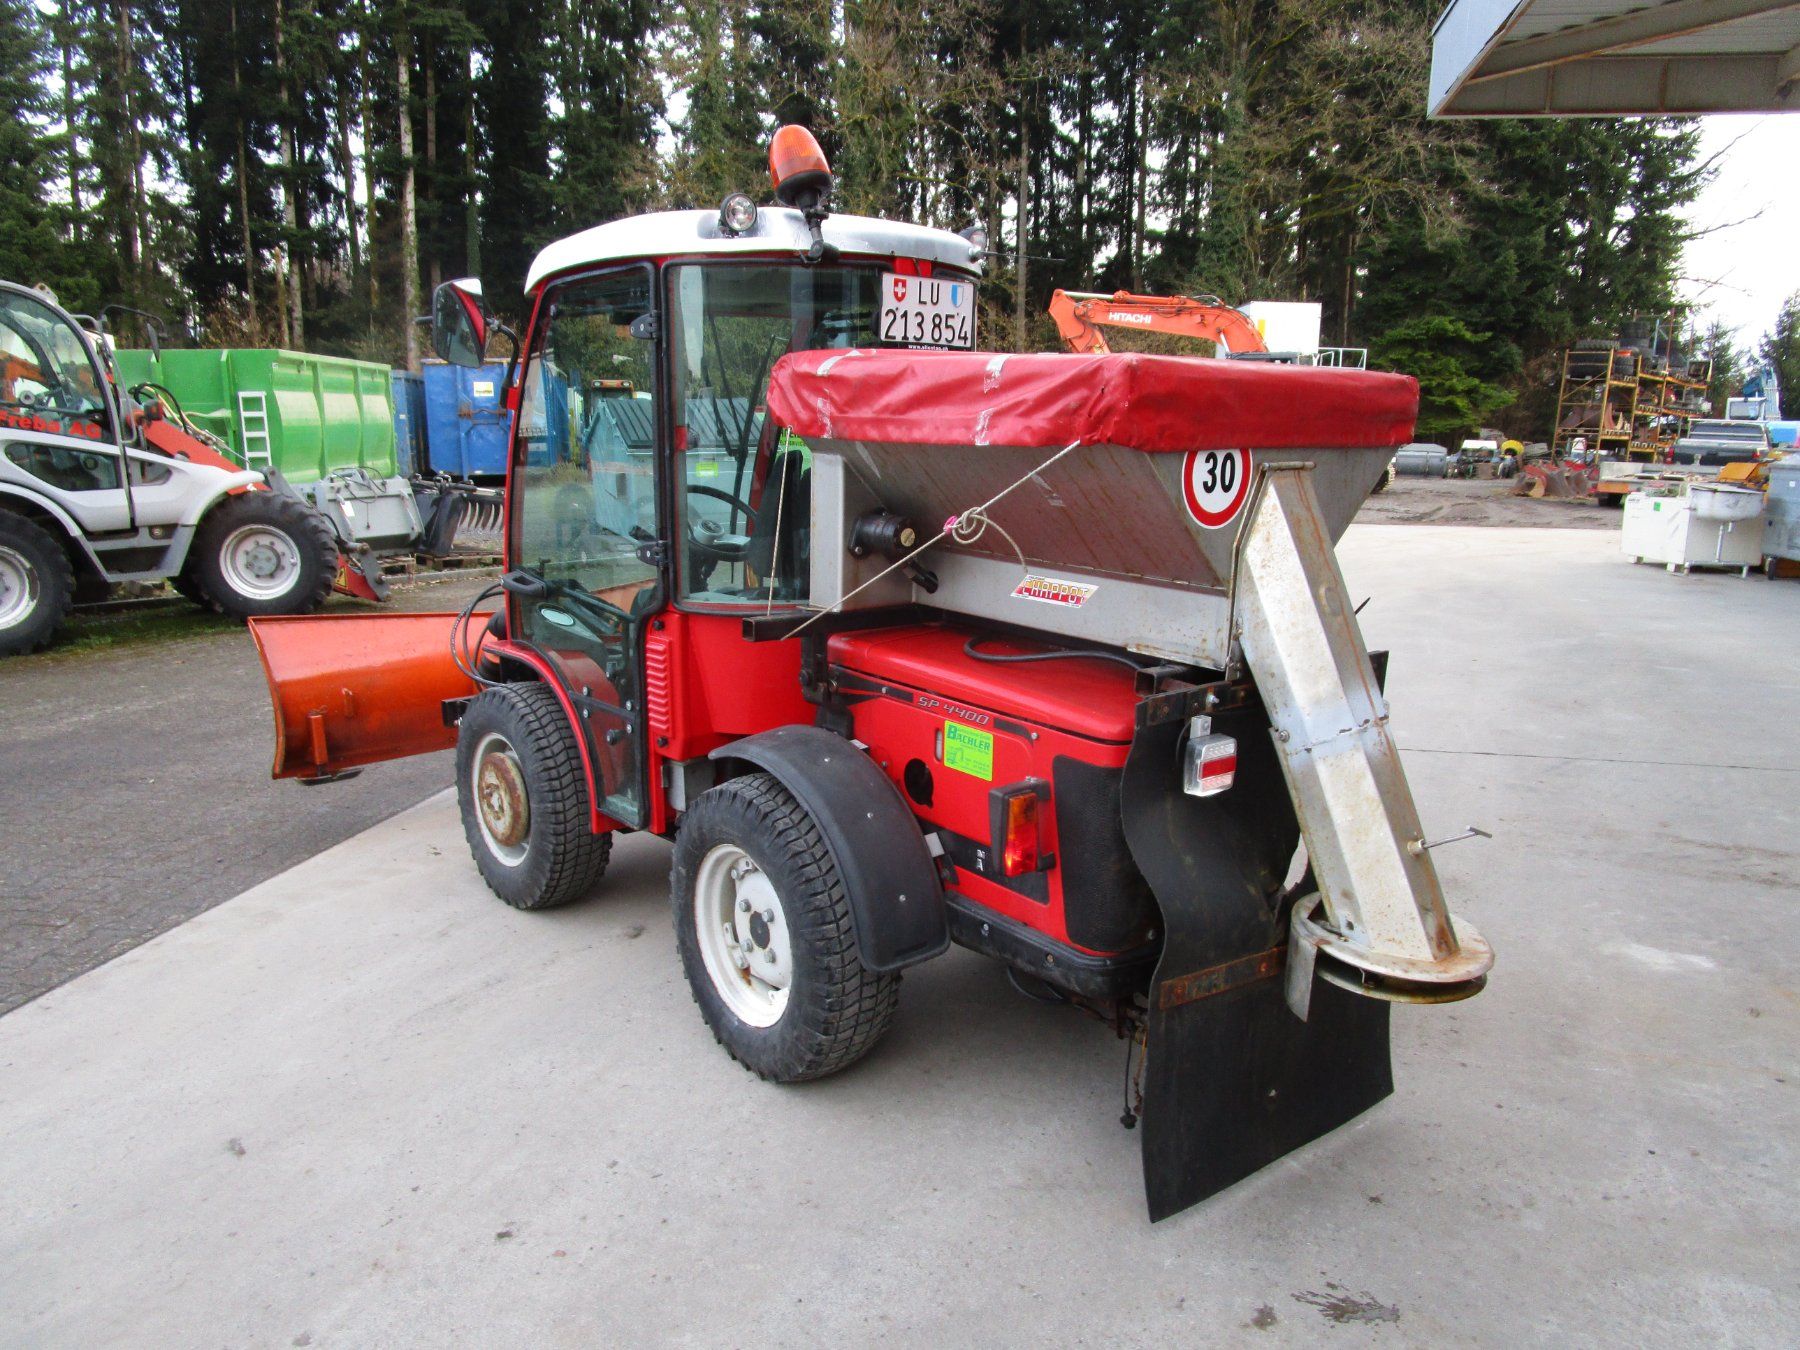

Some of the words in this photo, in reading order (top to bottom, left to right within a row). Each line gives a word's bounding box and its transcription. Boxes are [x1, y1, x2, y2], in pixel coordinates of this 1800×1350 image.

[918, 280, 940, 306] LU
[1108, 311, 1152, 324] HITACHI
[1202, 451, 1236, 494] 30
[1022, 579, 1088, 604] CHAPPOT
[918, 696, 940, 708] SP
[943, 704, 990, 725] 4400
